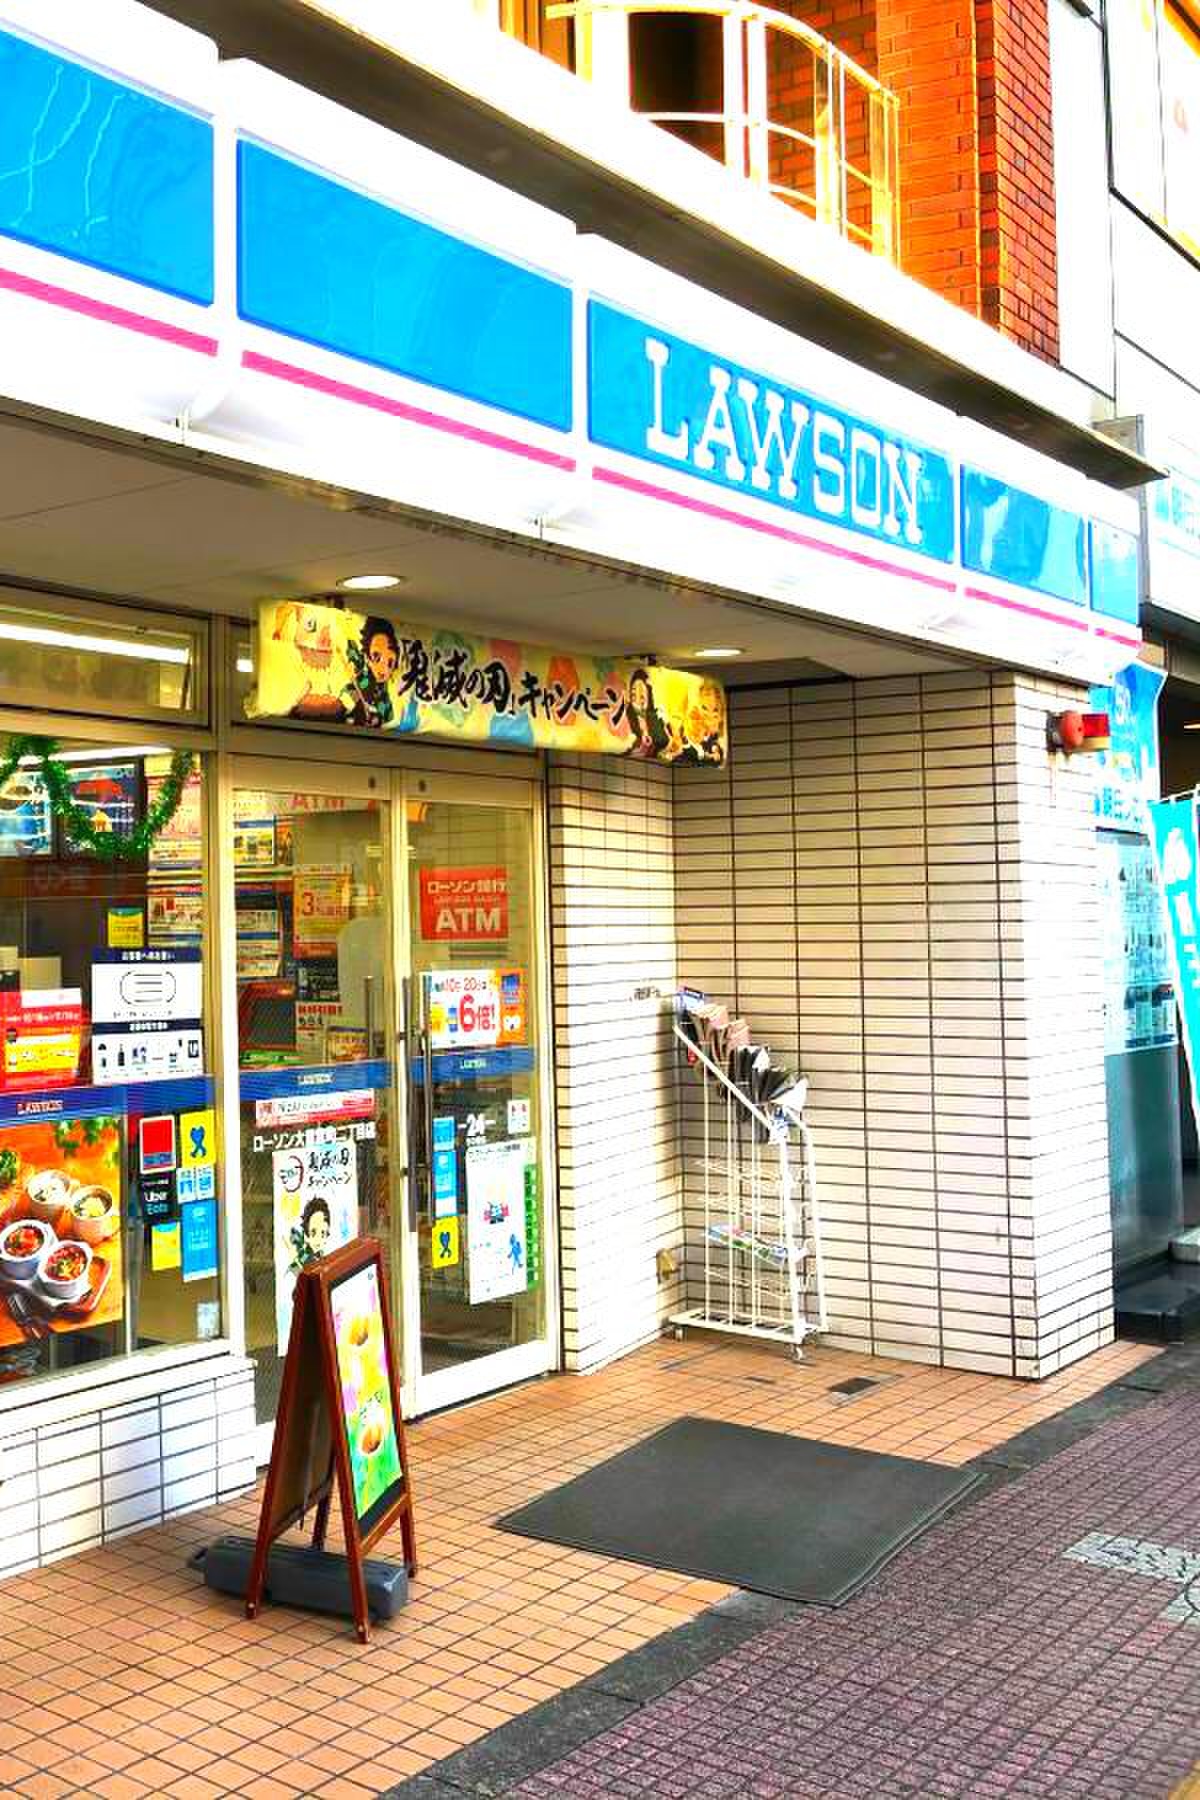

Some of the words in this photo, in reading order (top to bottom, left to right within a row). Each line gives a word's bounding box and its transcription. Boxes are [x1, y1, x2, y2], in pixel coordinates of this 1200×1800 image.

[645, 337, 923, 545] LAWSON
[427, 878, 507, 895] ローソン銀行
[436, 907, 501, 933] ATM
[144, 1190, 168, 1203] Uber
